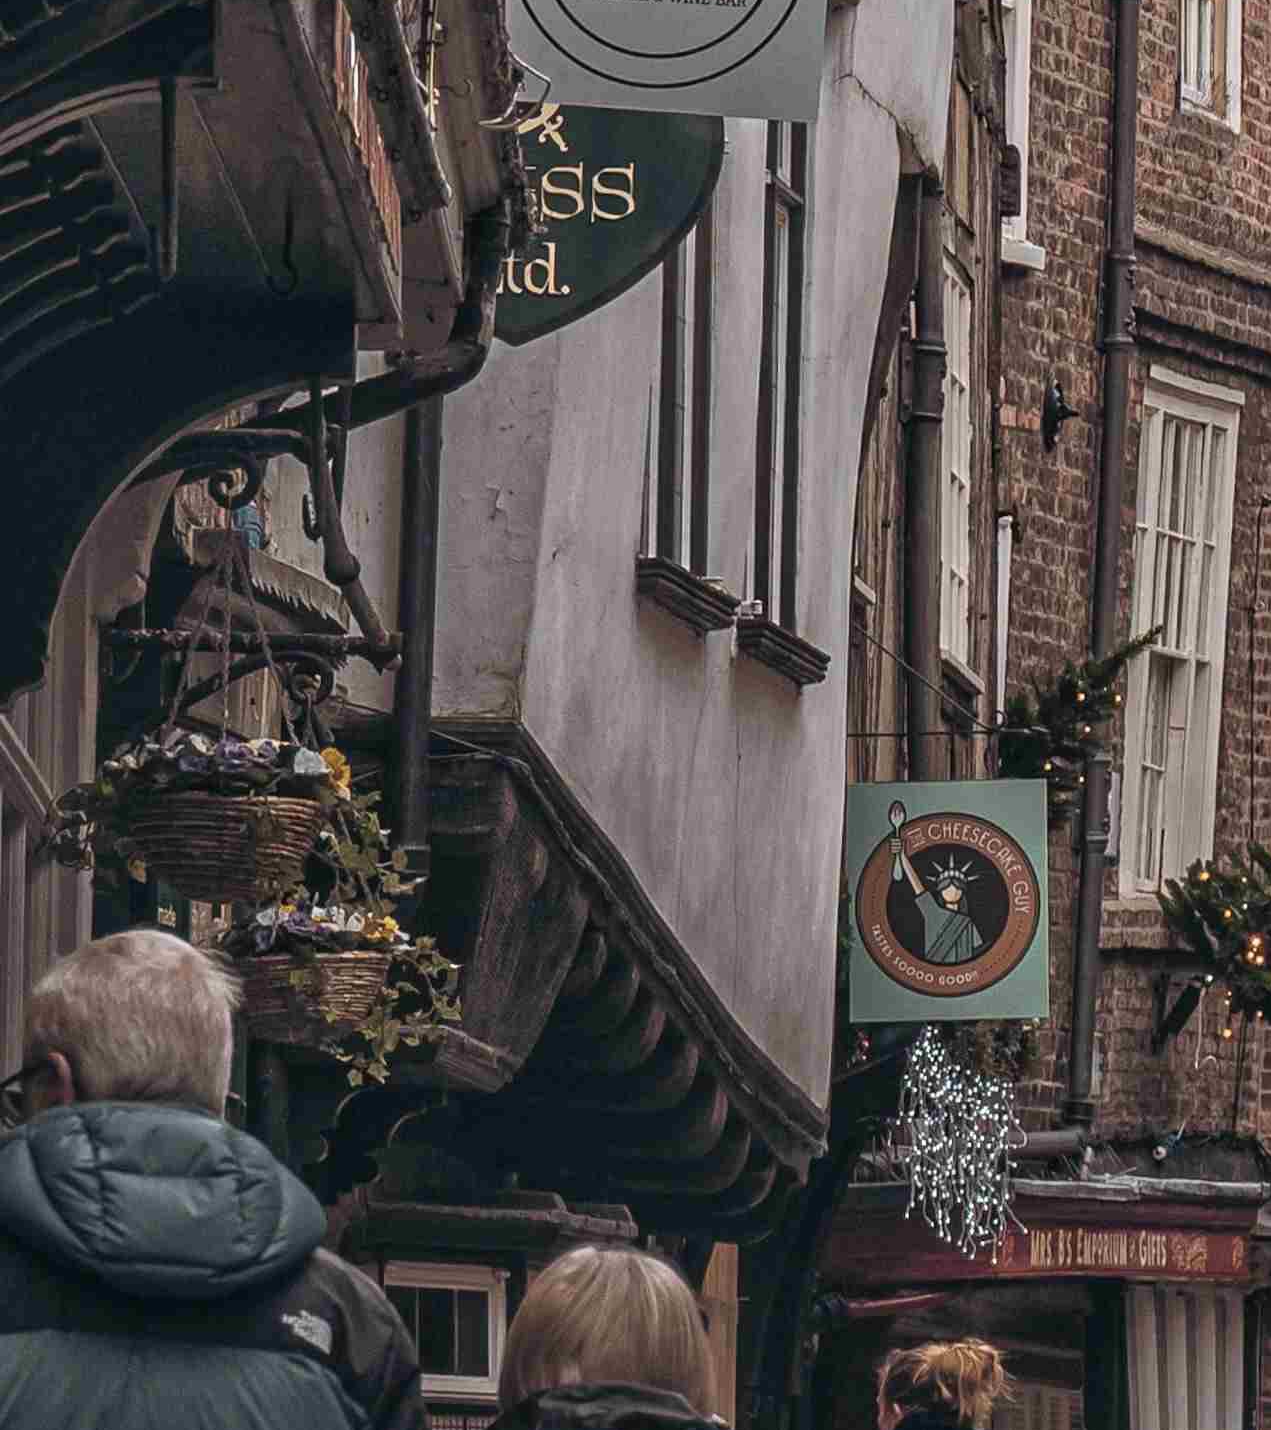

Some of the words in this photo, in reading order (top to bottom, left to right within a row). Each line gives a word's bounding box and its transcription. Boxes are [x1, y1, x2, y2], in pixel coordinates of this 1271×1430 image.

[525, 161, 637, 224] SS
[928, 822, 1023, 878] CHEESECAKE
[1012, 881, 1034, 915] GUY
[1077, 1228, 1128, 1268] EMPORIUM
[1139, 1230, 1168, 1268] GIFTS
